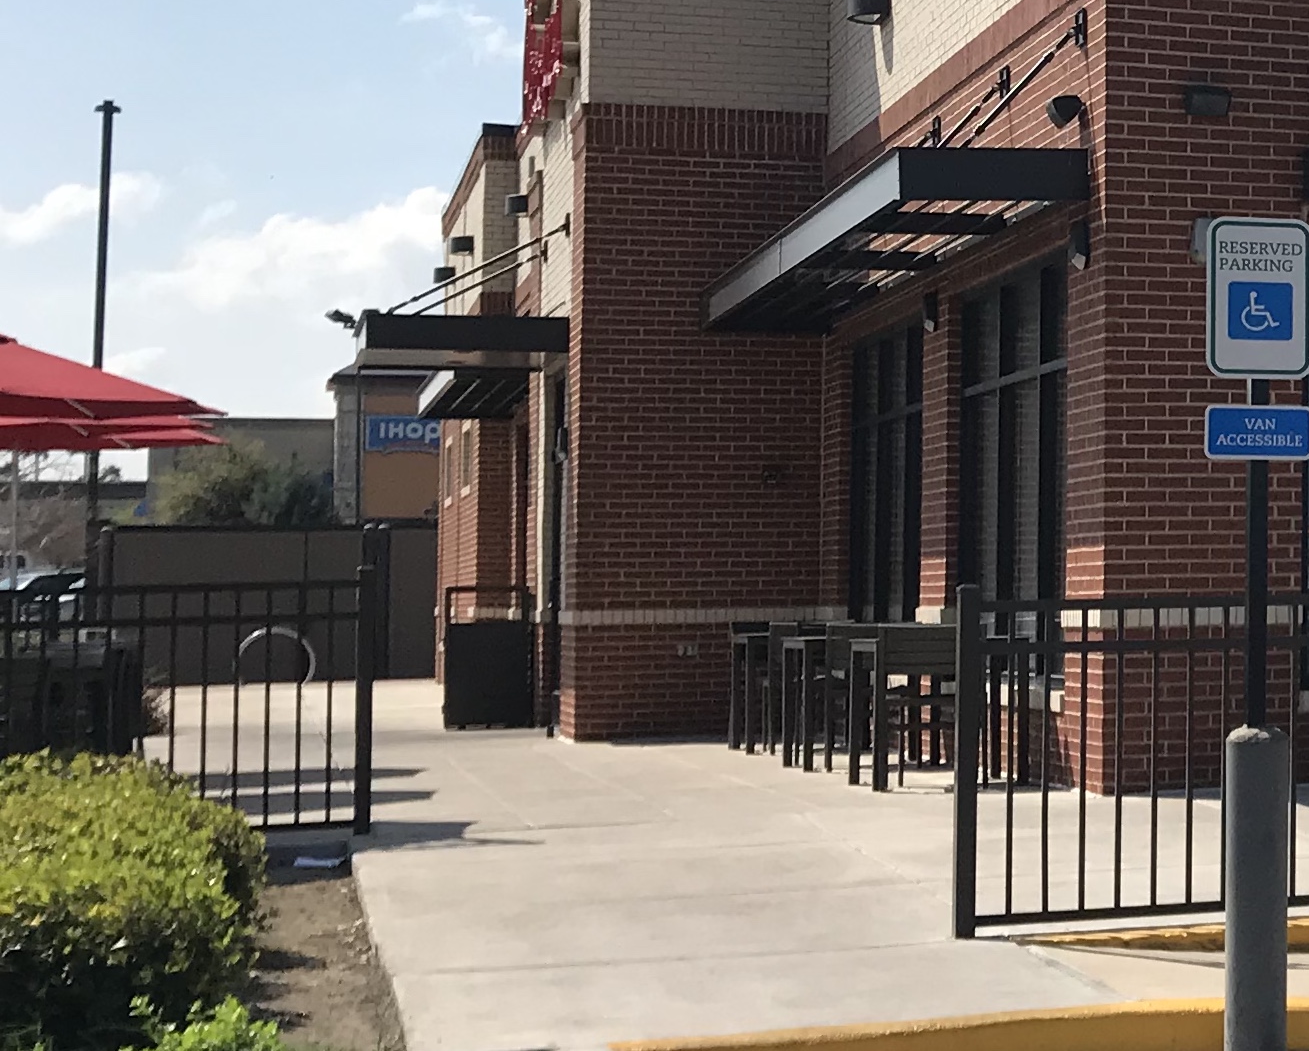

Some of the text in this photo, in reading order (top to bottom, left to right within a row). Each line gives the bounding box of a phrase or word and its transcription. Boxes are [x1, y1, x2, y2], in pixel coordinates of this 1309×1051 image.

[1218, 240, 1303, 256] RESERVED
[1219, 257, 1294, 273] PARKING
[378, 421, 440, 444] IHOP
[1244, 418, 1276, 431] VAN
[1215, 433, 1303, 448] ACCESSIBLE
